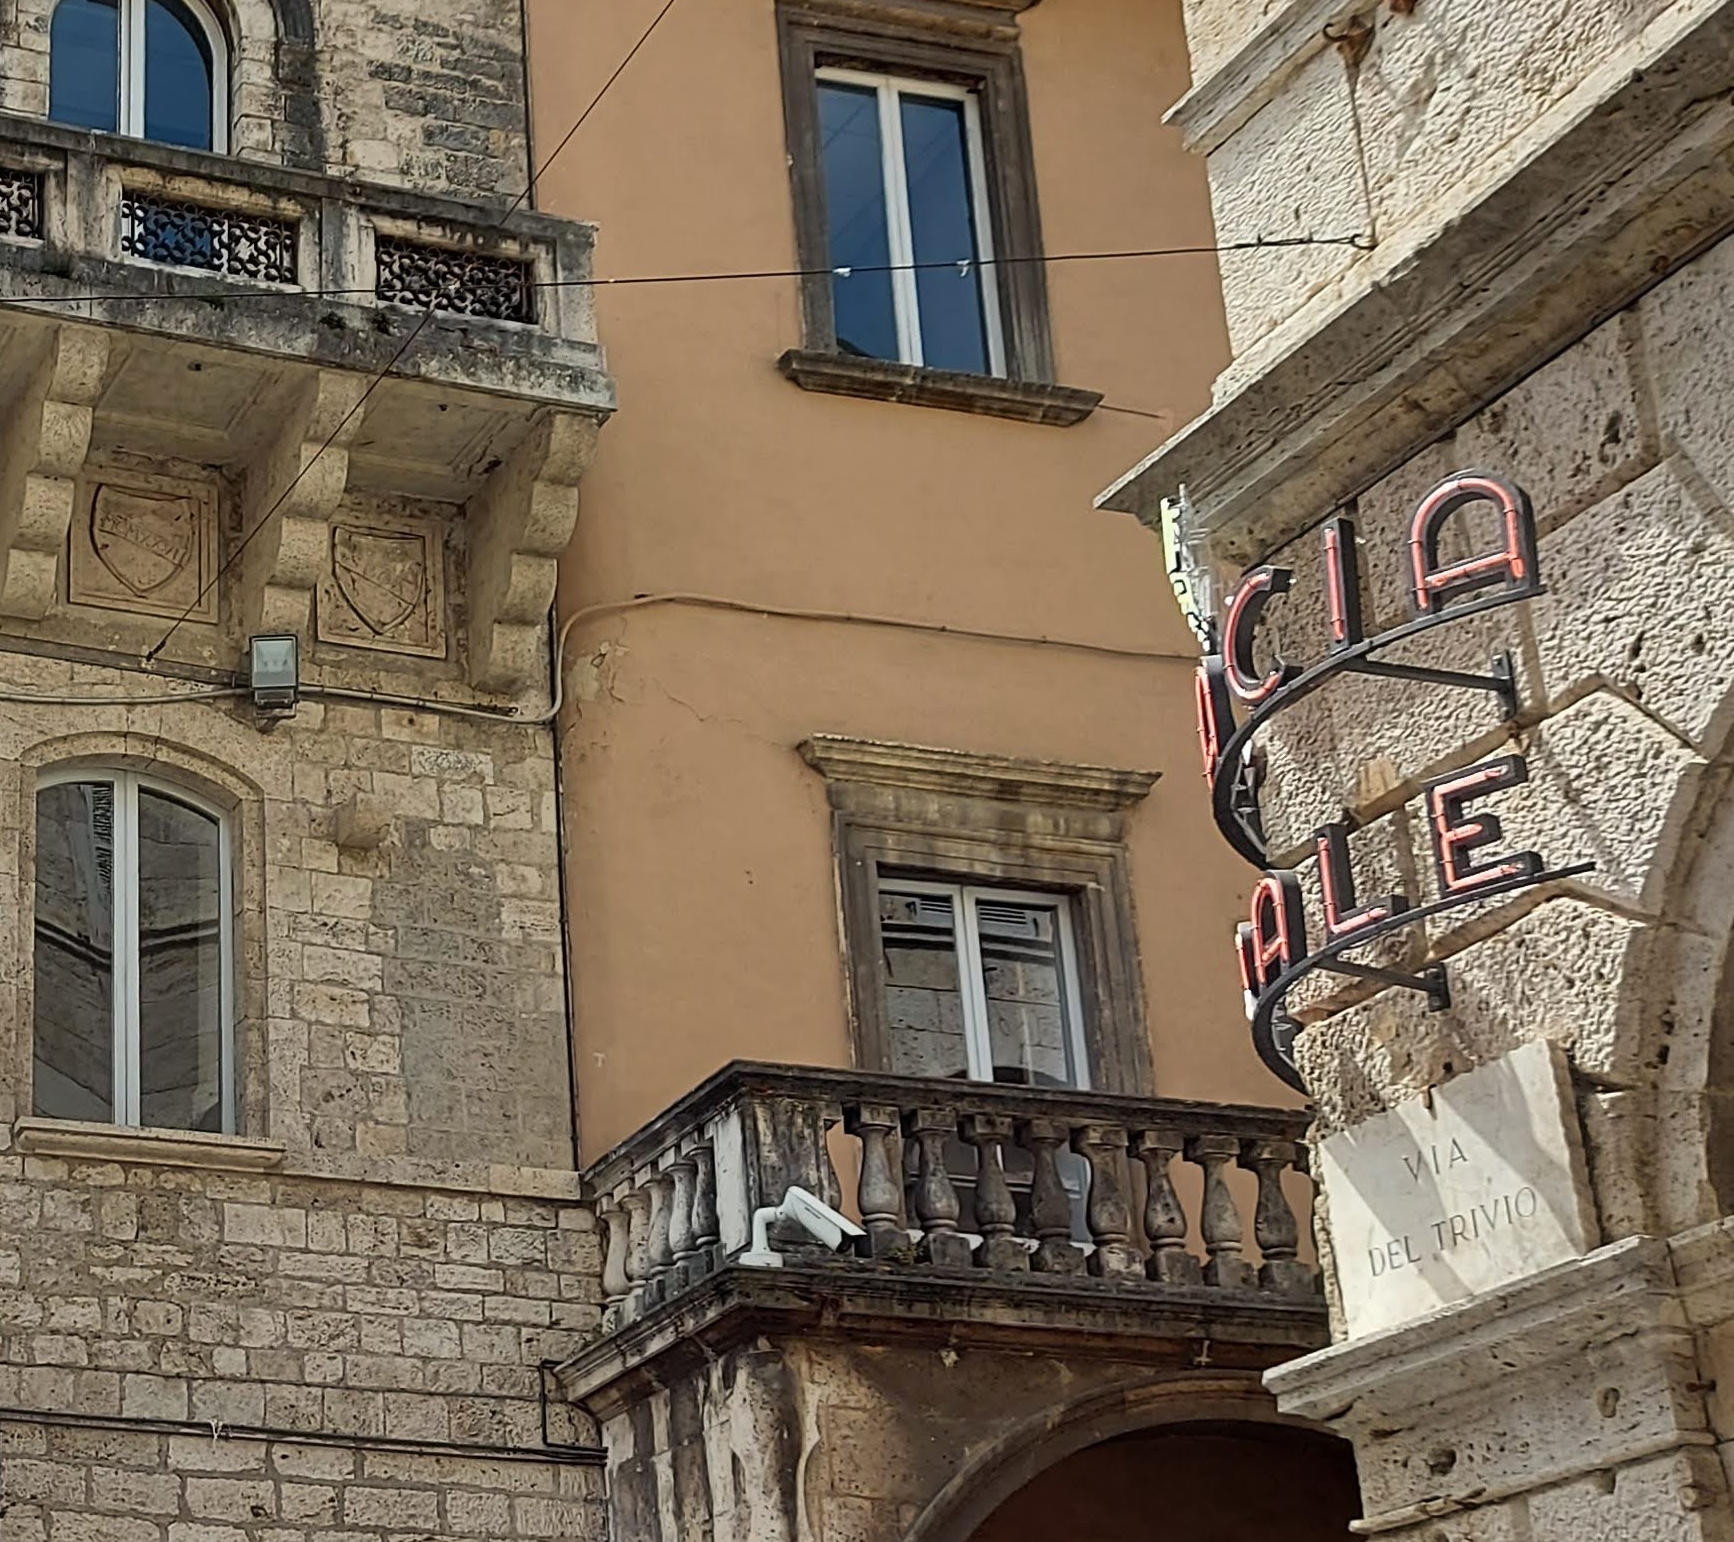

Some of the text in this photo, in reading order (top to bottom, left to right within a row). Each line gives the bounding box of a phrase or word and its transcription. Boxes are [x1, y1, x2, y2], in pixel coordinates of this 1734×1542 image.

[1402, 1137, 1468, 1181] VIA
[1368, 1186, 1537, 1277] DEL TRIVIO
